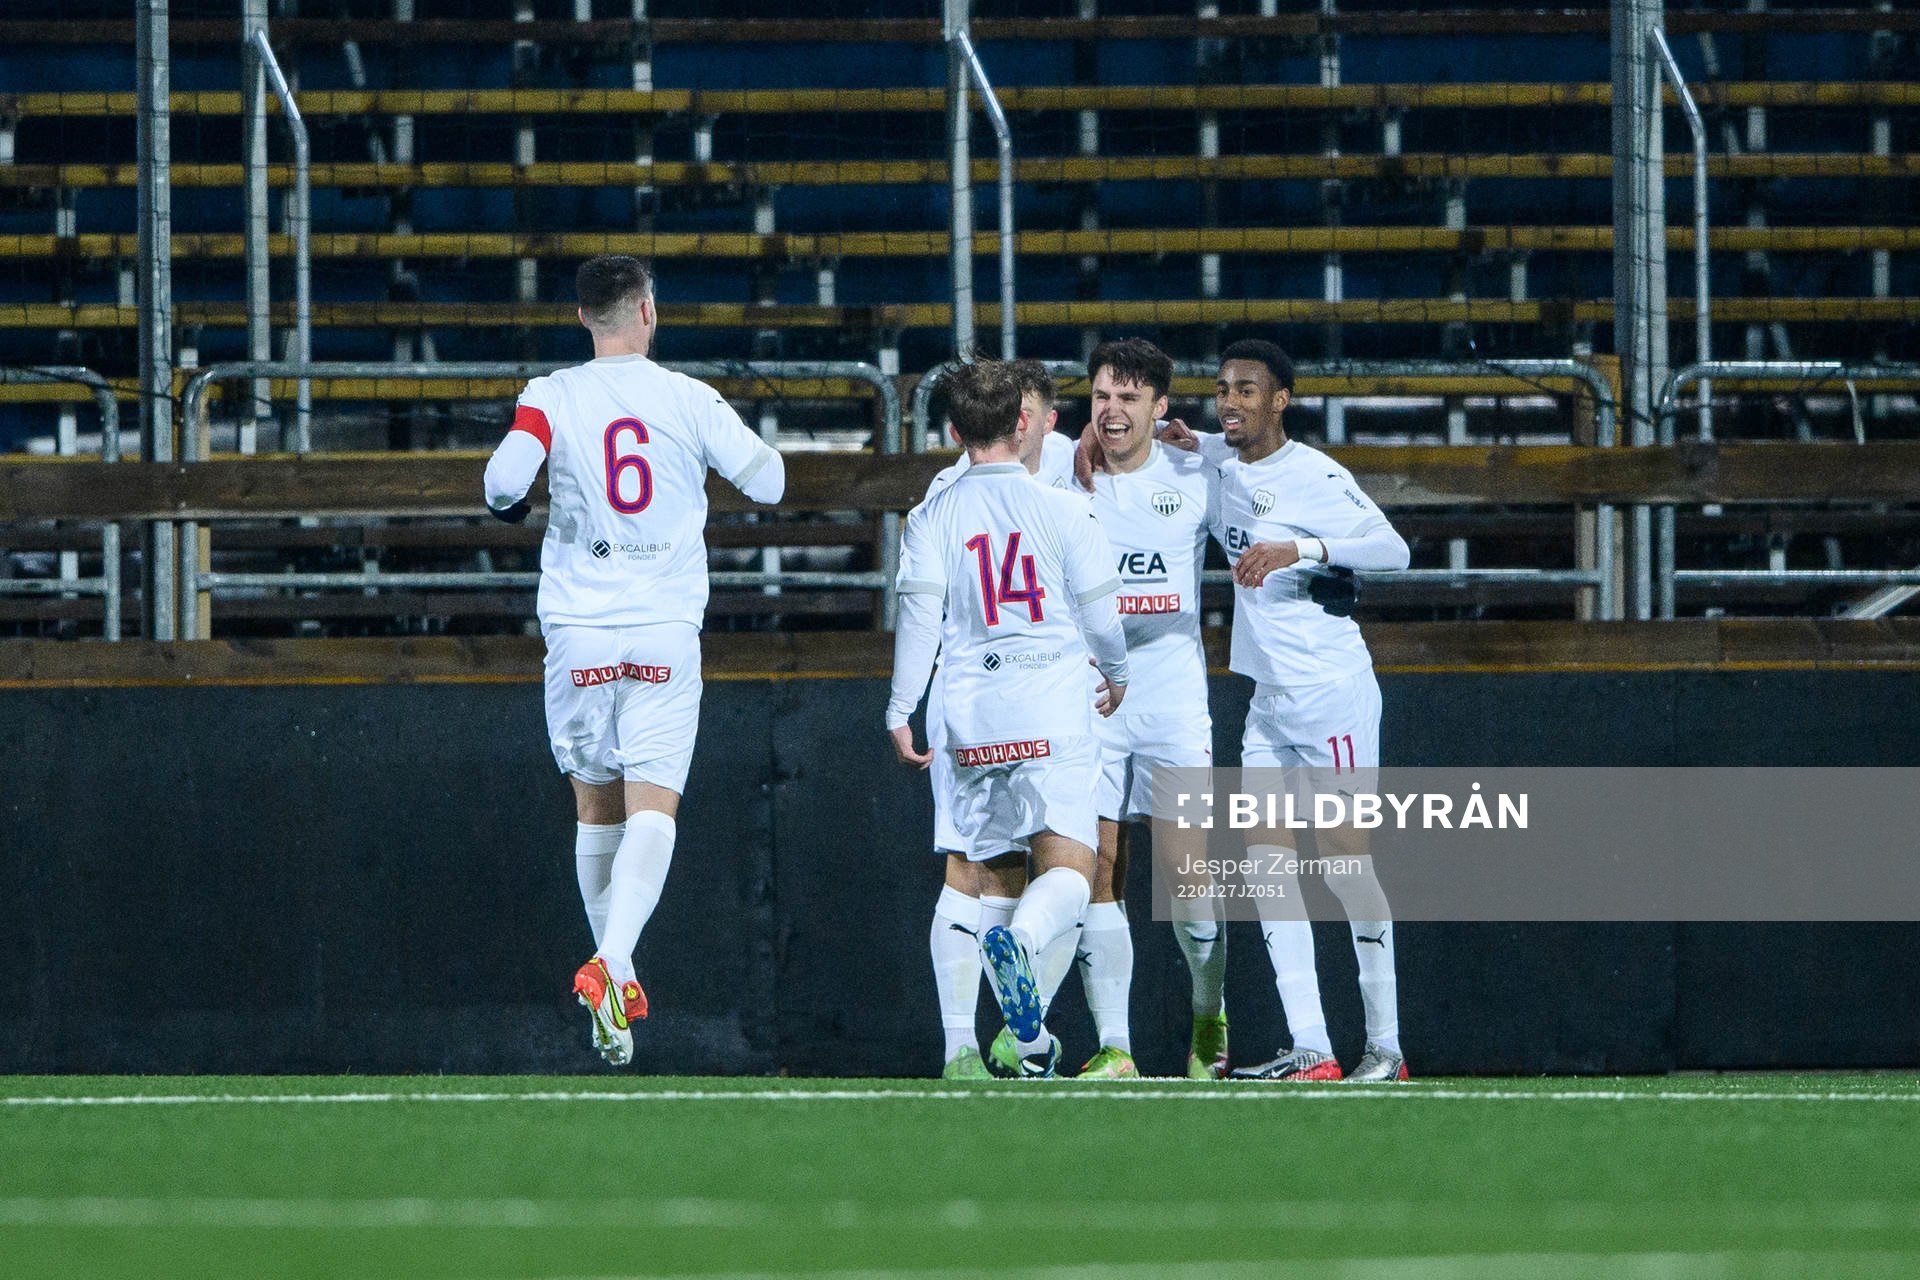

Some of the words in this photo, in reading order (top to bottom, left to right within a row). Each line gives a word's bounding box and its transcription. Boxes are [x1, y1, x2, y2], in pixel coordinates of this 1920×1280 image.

[604, 417, 652, 514] 6
[613, 541, 672, 553] EXCALIBUR
[1117, 552, 1167, 575] VEA
[965, 532, 1046, 626] 14
[1004, 651, 1061, 664] EXCALIBUR
[957, 741, 1050, 766] BAUHAUS
[1326, 733, 1356, 775] 11
